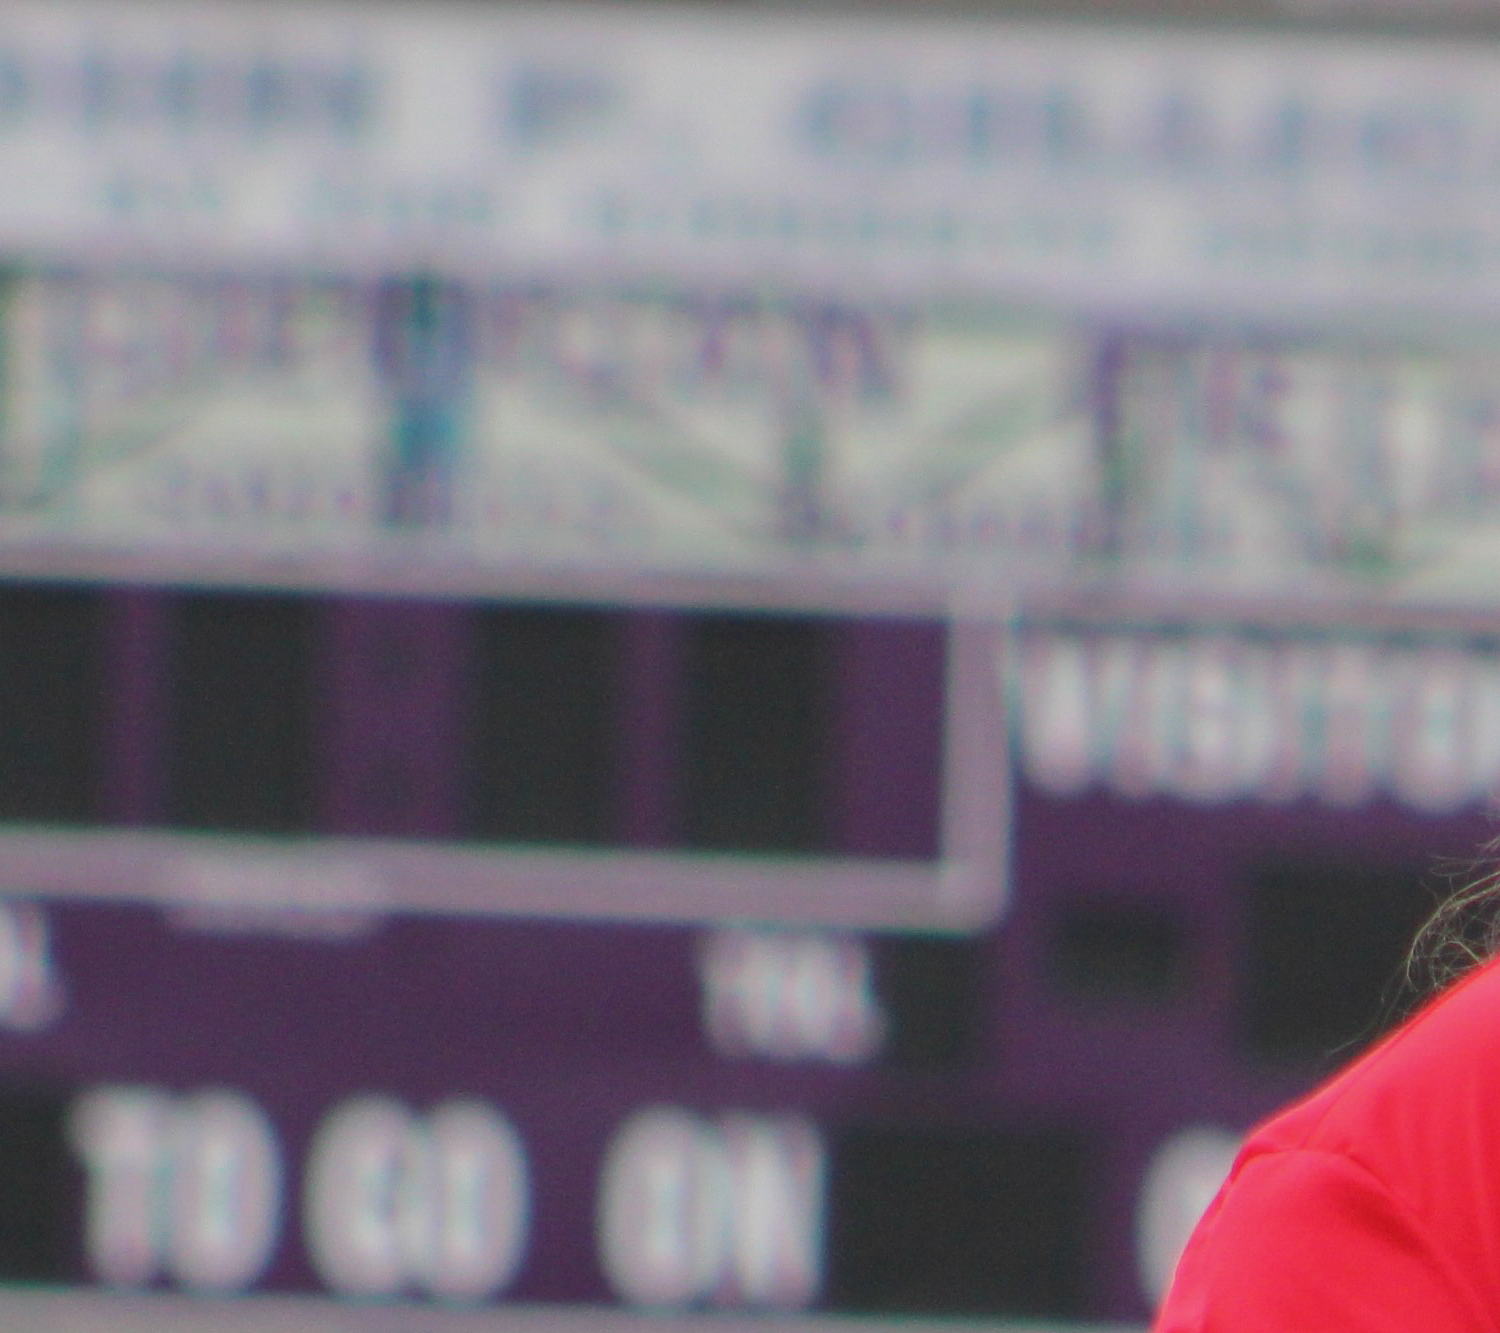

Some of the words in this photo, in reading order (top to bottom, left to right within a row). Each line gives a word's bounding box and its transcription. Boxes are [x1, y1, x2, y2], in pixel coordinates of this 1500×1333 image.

[72, 1085, 282, 1295] TO
[305, 1092, 530, 1308] GO
[598, 1105, 832, 1312] ON
